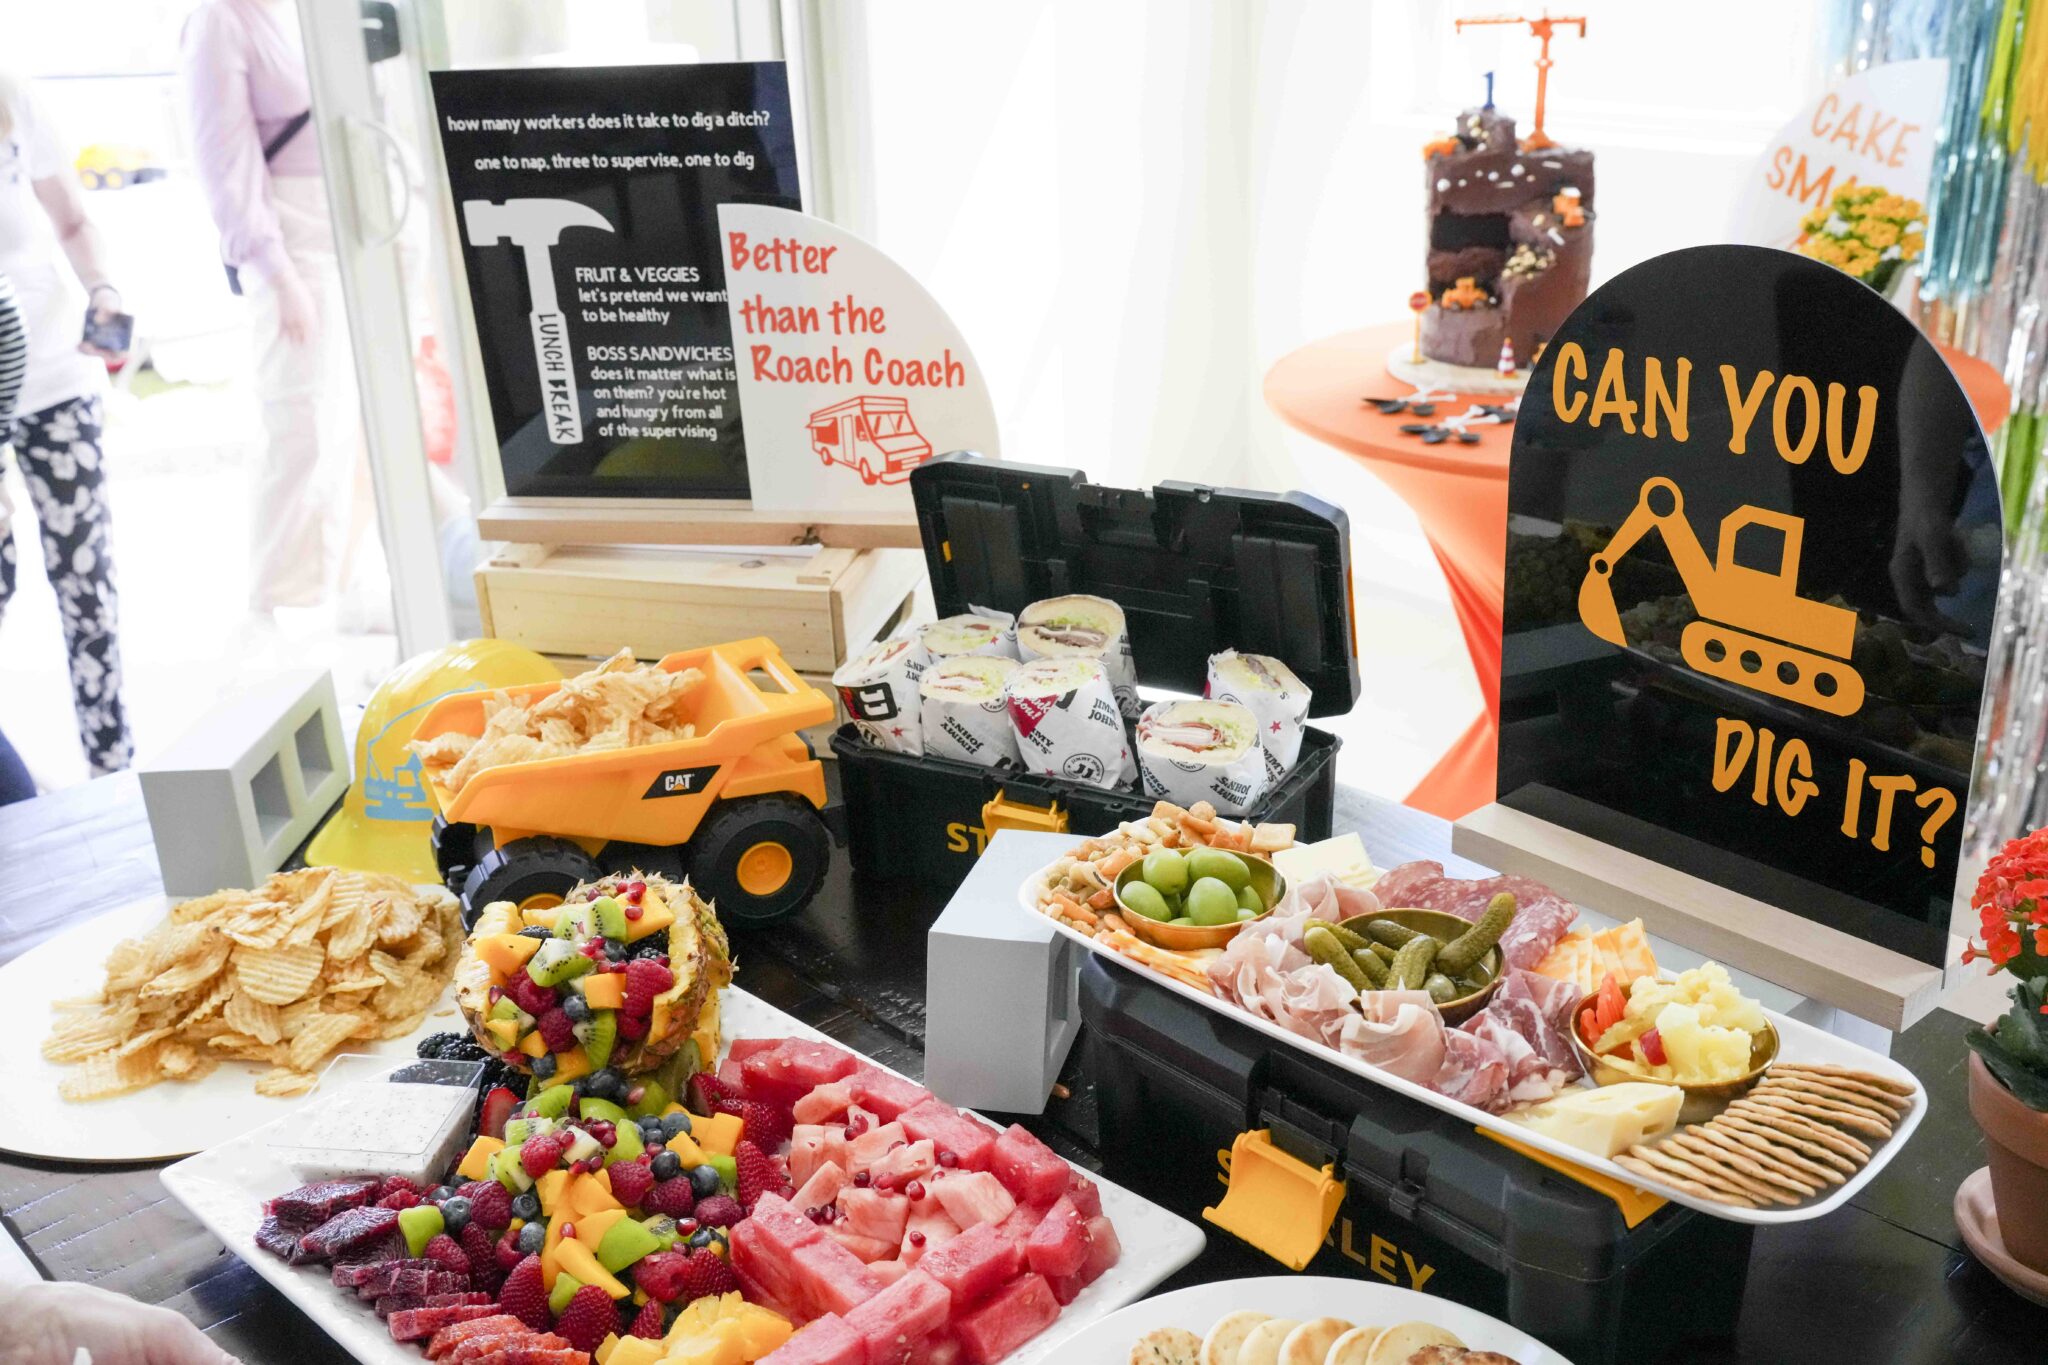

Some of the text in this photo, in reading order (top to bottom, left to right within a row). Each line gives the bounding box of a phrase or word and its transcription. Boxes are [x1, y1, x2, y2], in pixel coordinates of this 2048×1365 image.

[447, 111, 770, 134] how many workers does it take to dig a ditch?
[1811, 92, 1920, 168] CAKE
[475, 151, 755, 172] one to nap, three to supervise, one to dig
[728, 232, 838, 274] Better
[575, 267, 700, 283] FRUIT & VEGGIES
[578, 288, 729, 305] let's pretend we want
[582, 308, 670, 325] to be healthy
[739, 294, 887, 335] than the
[587, 346, 733, 362] BOSS SANDWICHES
[538, 313, 576, 440] LUNCH BREAK
[591, 367, 736, 381] does it matter what is
[750, 345, 965, 388] Roach Coach
[593, 385, 726, 403] on them? you're hot
[596, 405, 723, 421] and hungry from all
[1552, 341, 1879, 475] CAN YOU
[599, 423, 717, 441] of the supervising
[940, 722, 977, 755] JIMMY
[944, 715, 984, 749] JOHN'S
[665, 773, 690, 791] CAT
[1216, 776, 1251, 795] JOHN'S
[1711, 717, 1958, 869] DIG IT?
[1210, 783, 1247, 806] JIMMY
[1217, 1148, 1436, 1292] SLEY
